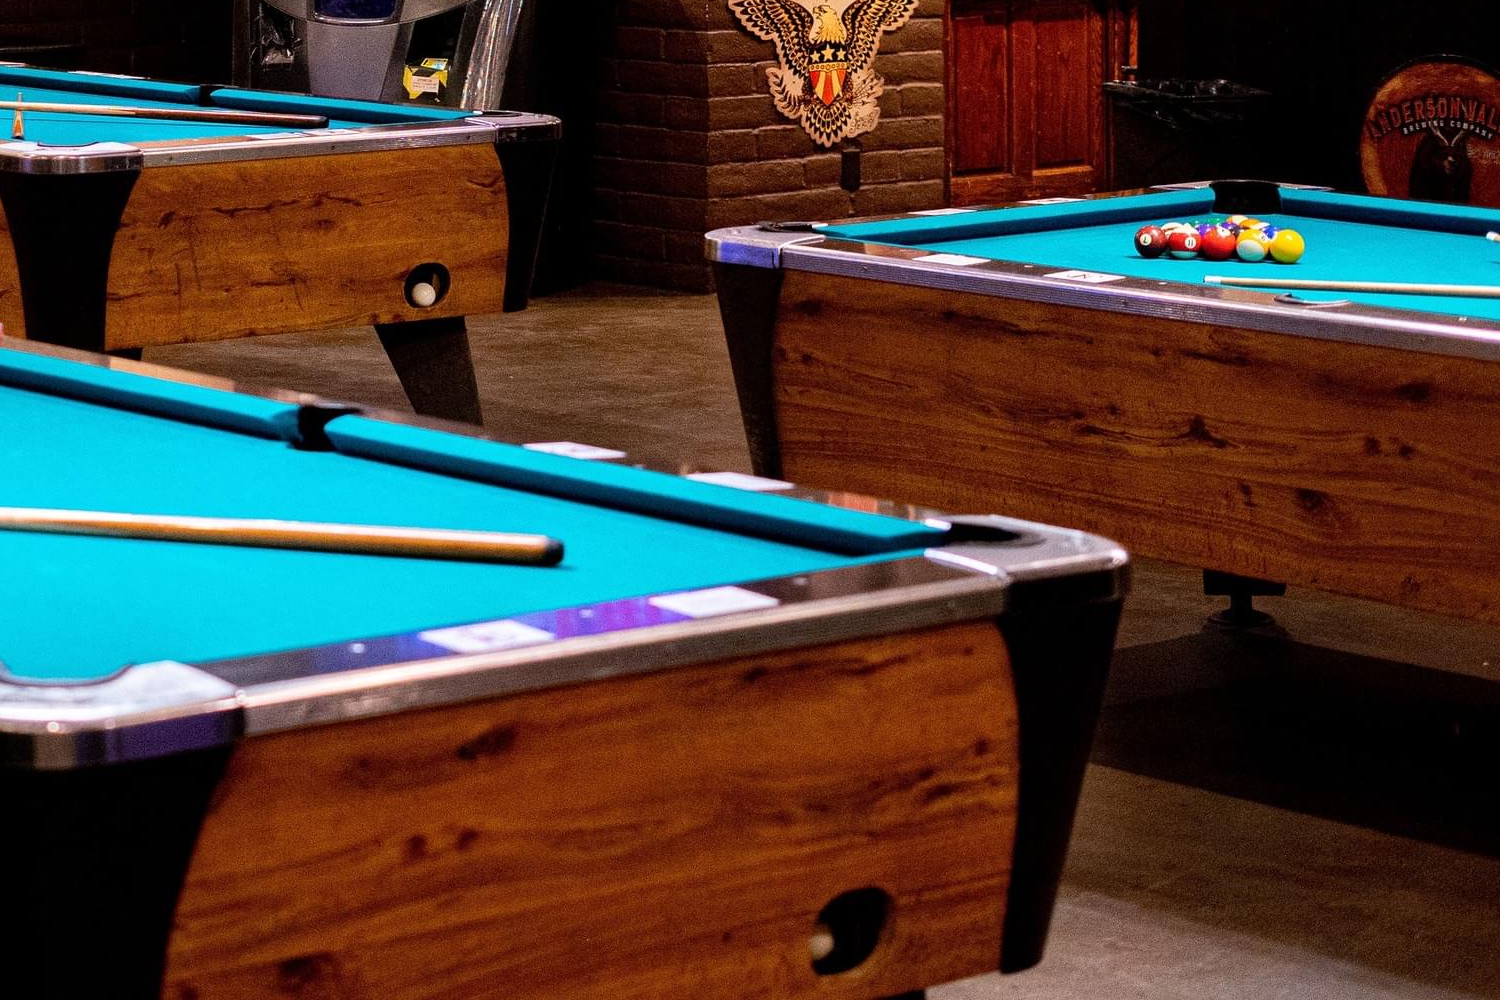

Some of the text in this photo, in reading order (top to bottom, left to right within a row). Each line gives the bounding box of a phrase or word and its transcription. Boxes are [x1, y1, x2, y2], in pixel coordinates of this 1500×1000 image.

[1365, 97, 1500, 140] ANDERSON VAL
[1402, 120, 1493, 139] BREWING COMPANY
[1187, 238, 1194, 247] 11
